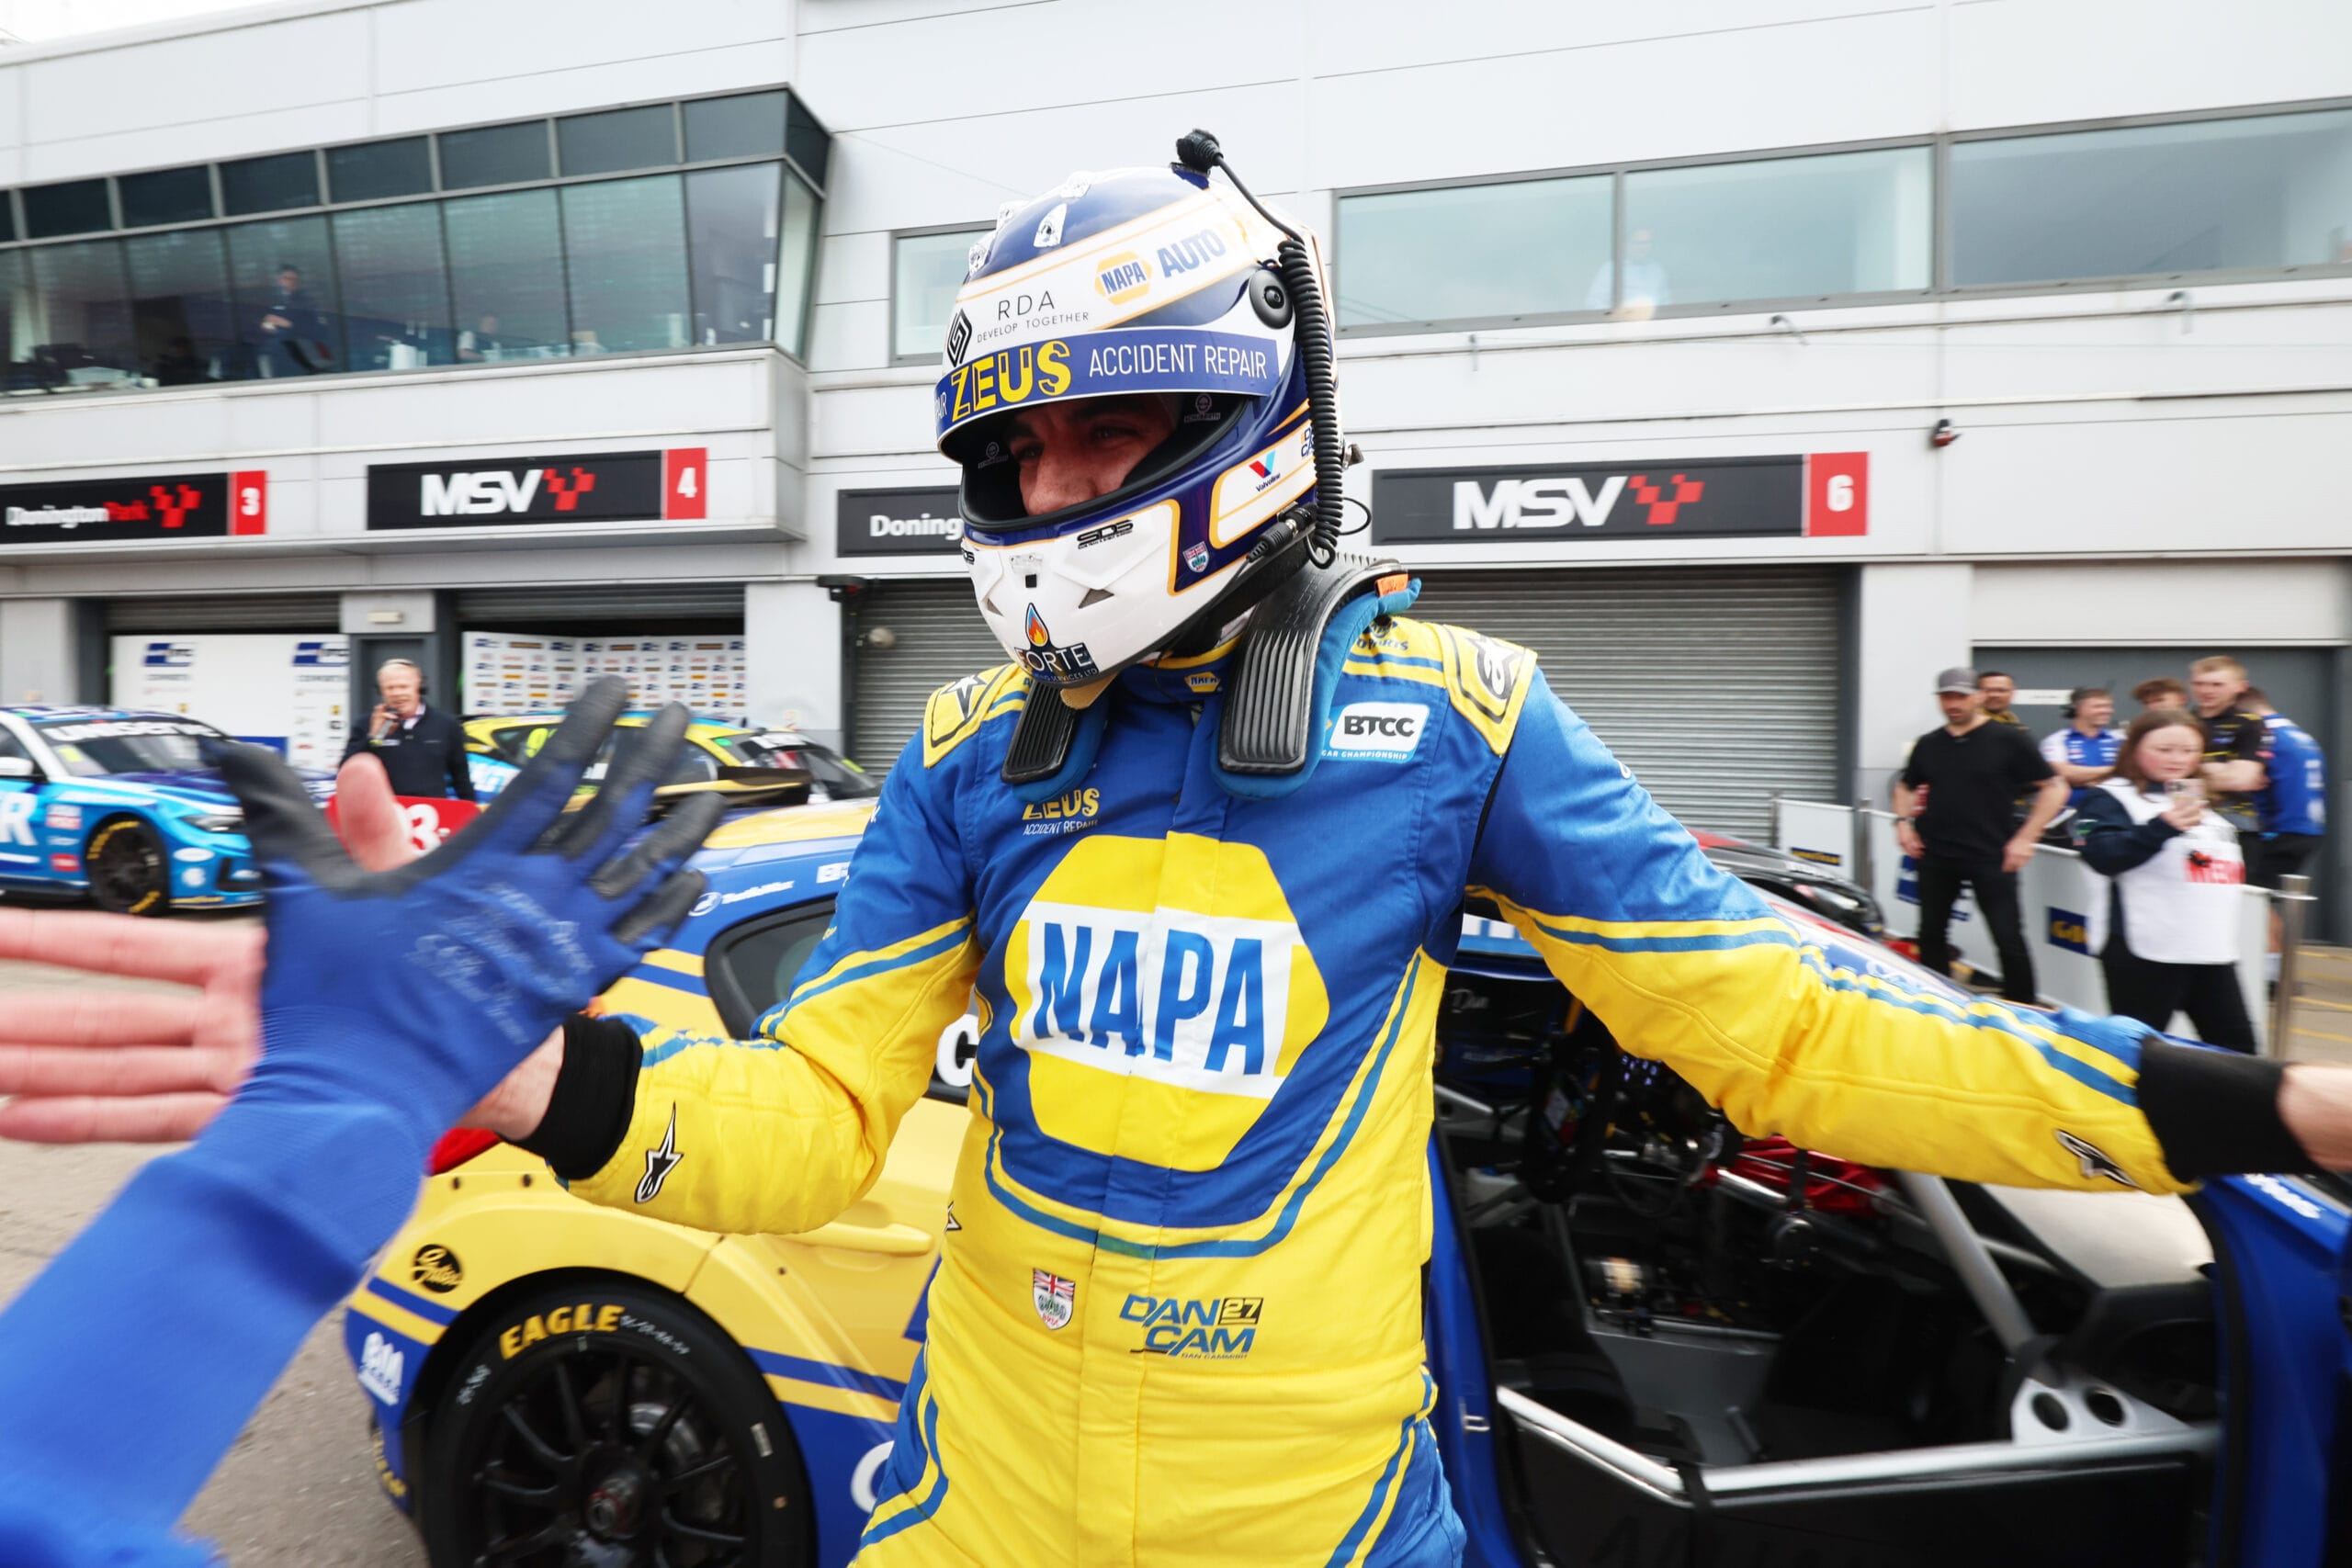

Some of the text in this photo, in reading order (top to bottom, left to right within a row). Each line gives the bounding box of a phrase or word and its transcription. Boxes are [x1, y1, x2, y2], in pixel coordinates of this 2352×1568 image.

[1101, 261, 1147, 295] NAPA
[1157, 228, 1227, 278] AUTO
[998, 290, 1055, 321] RDA
[977, 311, 1089, 344] DEVELOP TOGETHER
[951, 340, 1268, 423] ZEUS ACCIDENT REPAIR
[420, 468, 545, 516] MSV
[676, 468, 697, 498] 4
[1826, 474, 1854, 512] 6
[241, 486, 261, 516] 3
[1453, 475, 1628, 529] MSV
[1343, 715, 1415, 738] BTCC
[1023, 822, 1063, 837] ACCIDENT
[1033, 921, 1263, 1077] NAPA
[1119, 1293, 1260, 1328] DAN 27
[499, 1303, 626, 1360] EAGLE
[1145, 1325, 1256, 1358] CAM
